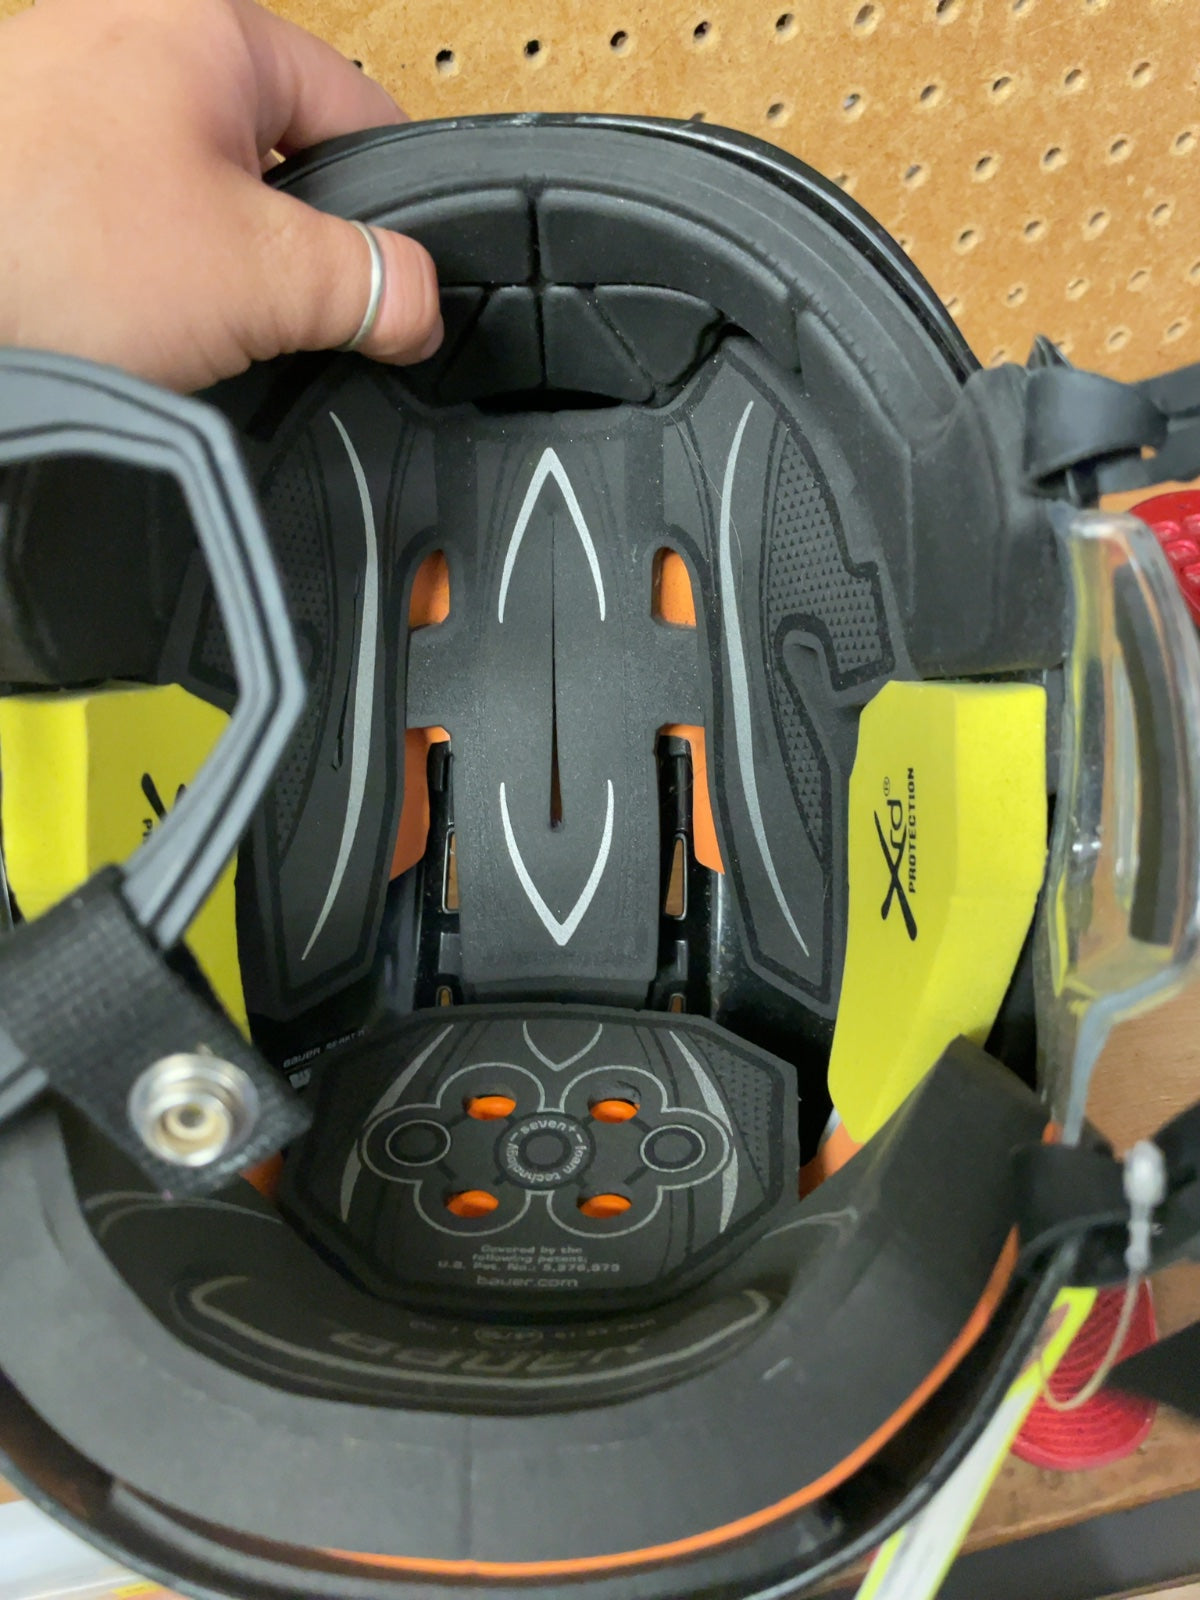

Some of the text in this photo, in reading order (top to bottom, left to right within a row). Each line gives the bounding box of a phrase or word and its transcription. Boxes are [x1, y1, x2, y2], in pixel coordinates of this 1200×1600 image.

[907, 767, 916, 894] PROTECTION
[506, 1142, 561, 1184] technology
[481, 1244, 583, 1256] Covered by the
[472, 1253, 533, 1264] following
[476, 1274, 579, 1288] bauer.com
